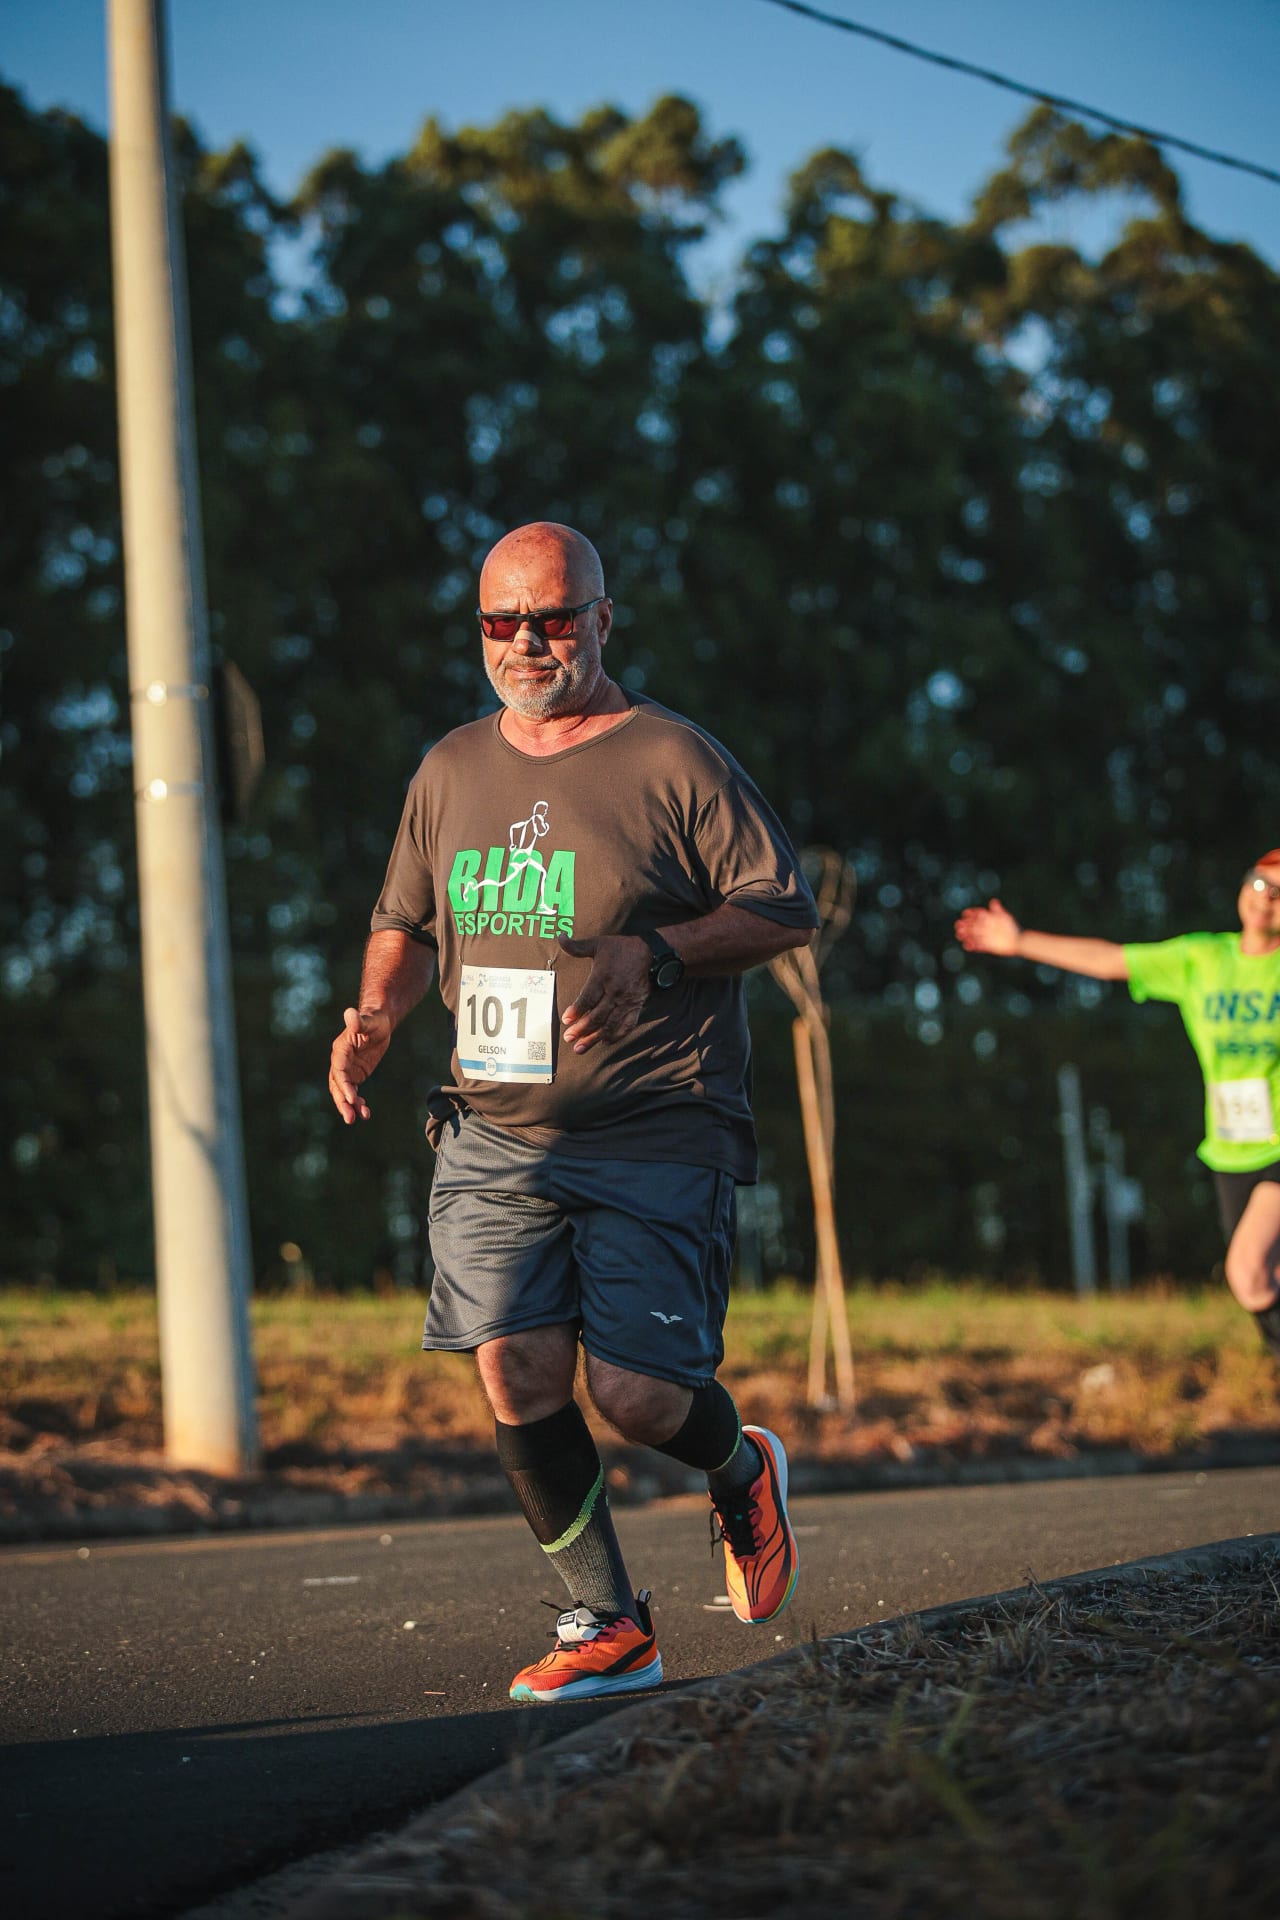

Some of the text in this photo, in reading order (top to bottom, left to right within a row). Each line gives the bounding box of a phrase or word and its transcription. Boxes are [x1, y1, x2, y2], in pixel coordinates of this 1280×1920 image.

[448, 847, 576, 917] BIDA
[454, 913, 574, 940] ESPORTES
[467, 994, 528, 1039] 101
[478, 1044, 507, 1056] GELSON
